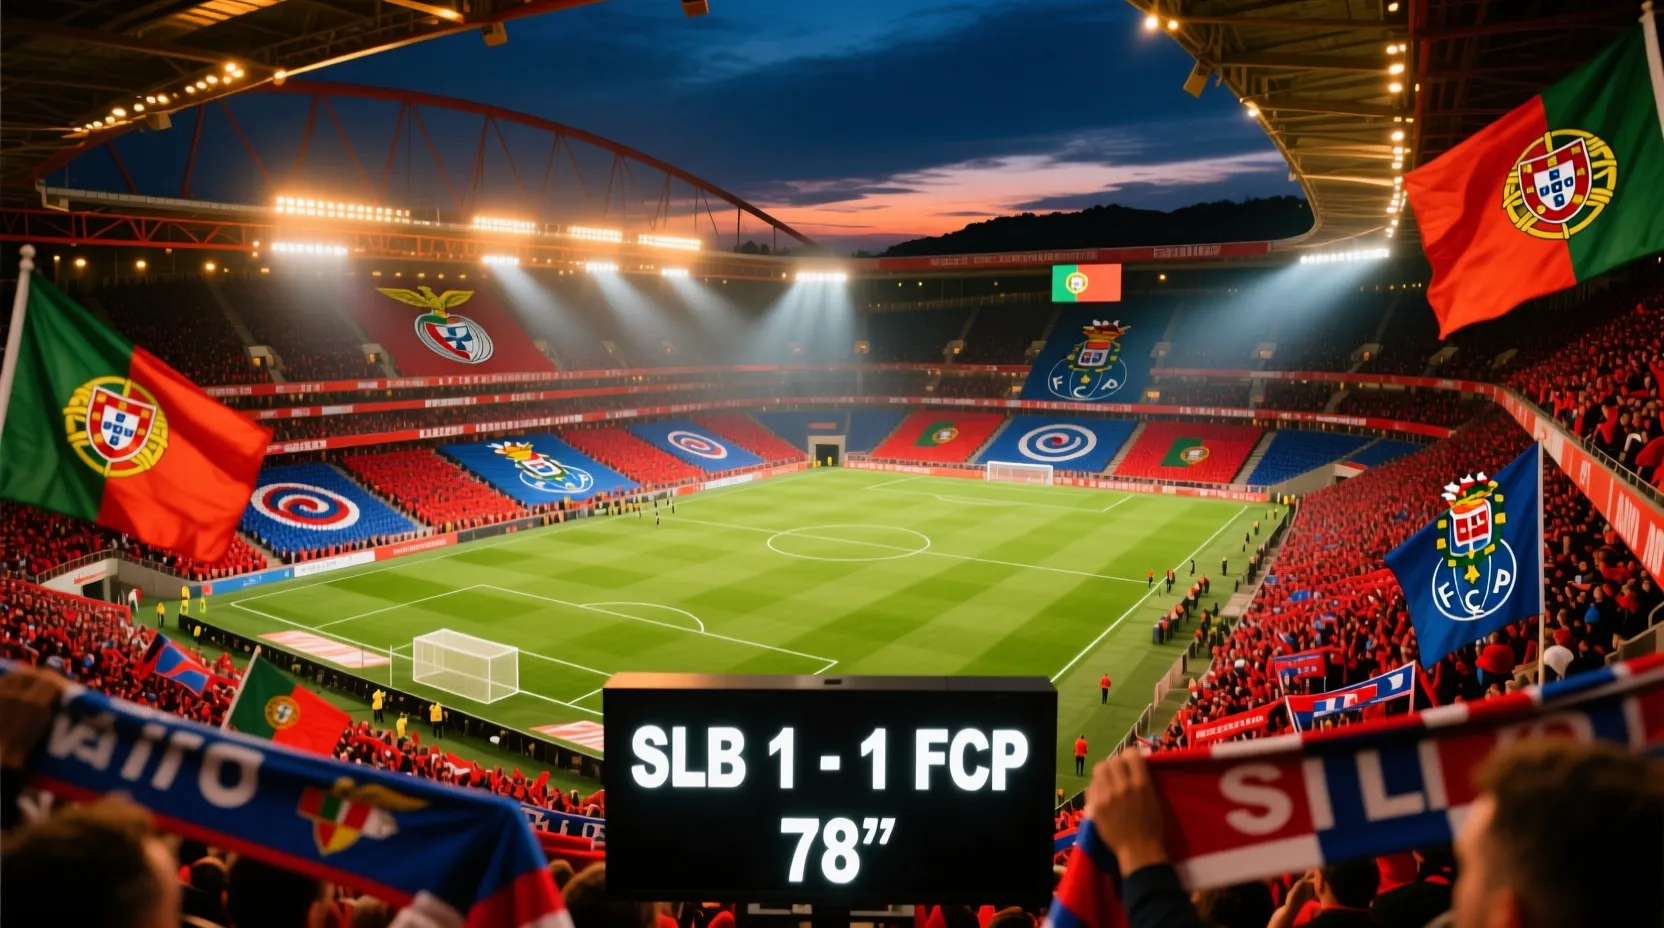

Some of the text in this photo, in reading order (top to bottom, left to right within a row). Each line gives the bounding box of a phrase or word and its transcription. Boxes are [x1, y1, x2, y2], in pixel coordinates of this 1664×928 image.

[631, 725, 746, 788] SLB
[769, 727, 793, 788] 1
[861, 728, 886, 789] 1
[916, 728, 1028, 791] FCP
